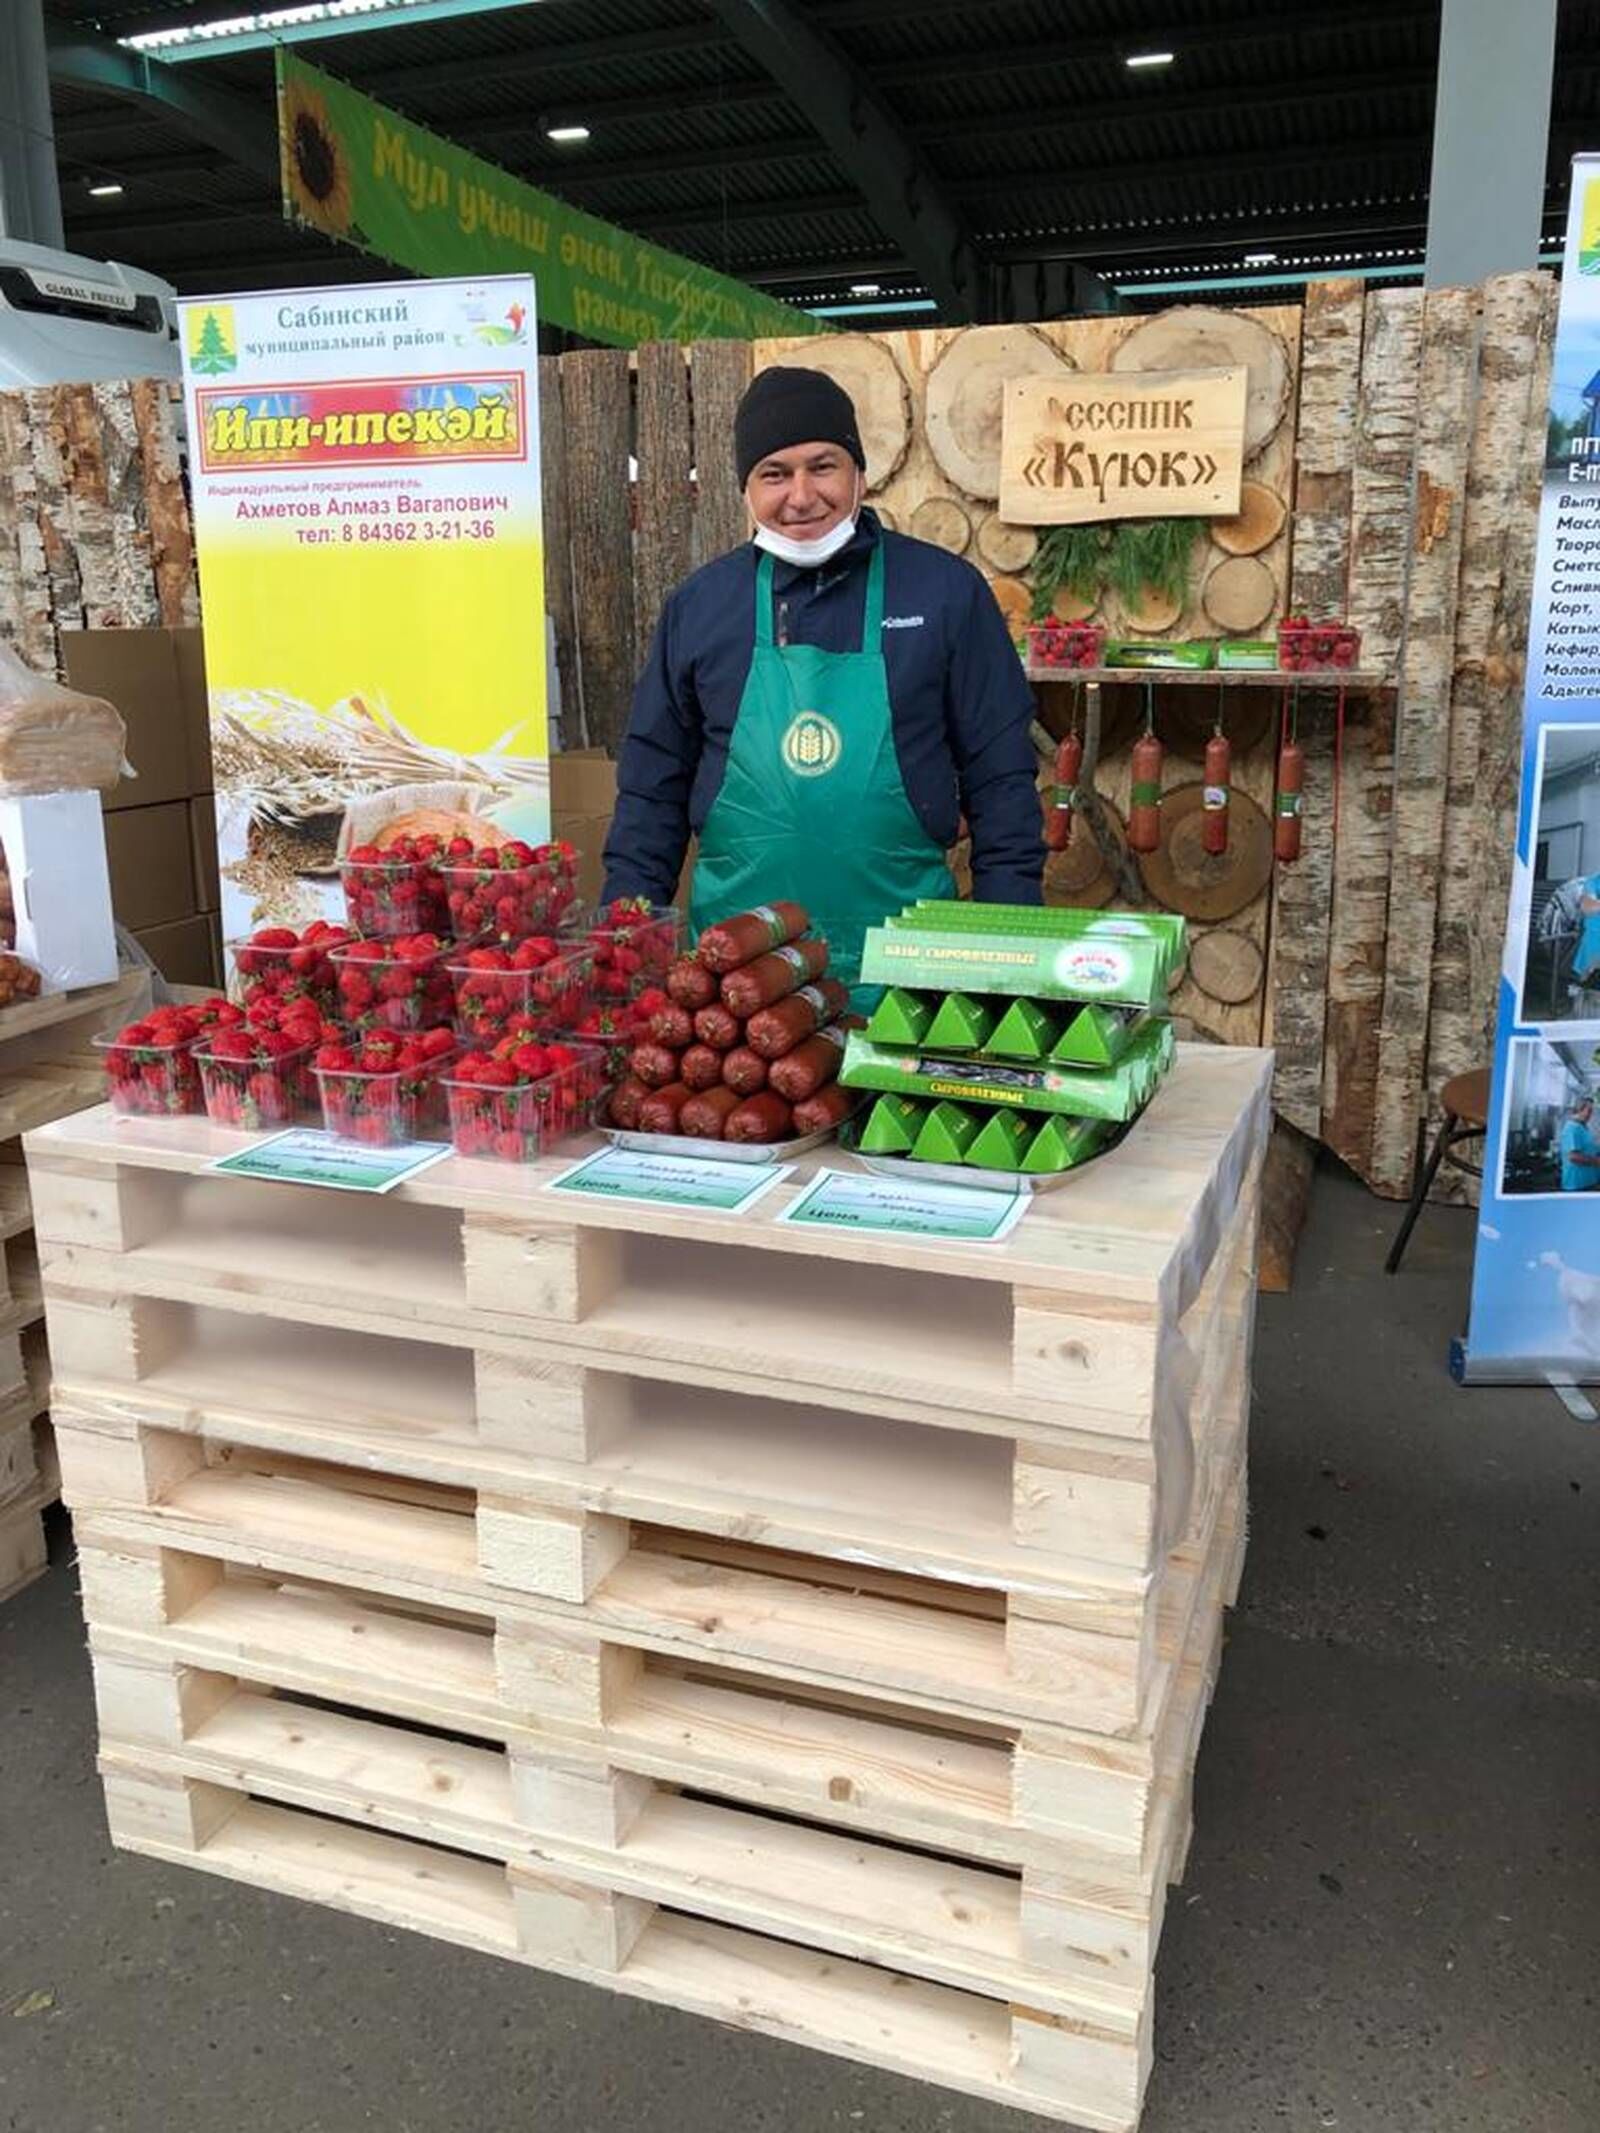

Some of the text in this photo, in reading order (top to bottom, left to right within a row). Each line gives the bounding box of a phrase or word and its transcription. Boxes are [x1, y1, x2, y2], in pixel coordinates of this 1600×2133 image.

[373, 118, 448, 211] Мул
[45, 283, 88, 300] GLOBAL
[277, 300, 409, 329] Сабинский
[245, 328, 445, 358] муниципальный район
[211, 396, 508, 451] Ипи-ипекәй
[207, 480, 309, 497] Индивидуальный
[236, 494, 508, 519] Ахметов Алмаз Вагапович
[296, 519, 495, 544] тел: 8 84362 3-21-36
[1549, 601, 1592, 617] Корт,
[808, 1208, 860, 1222] Цена
